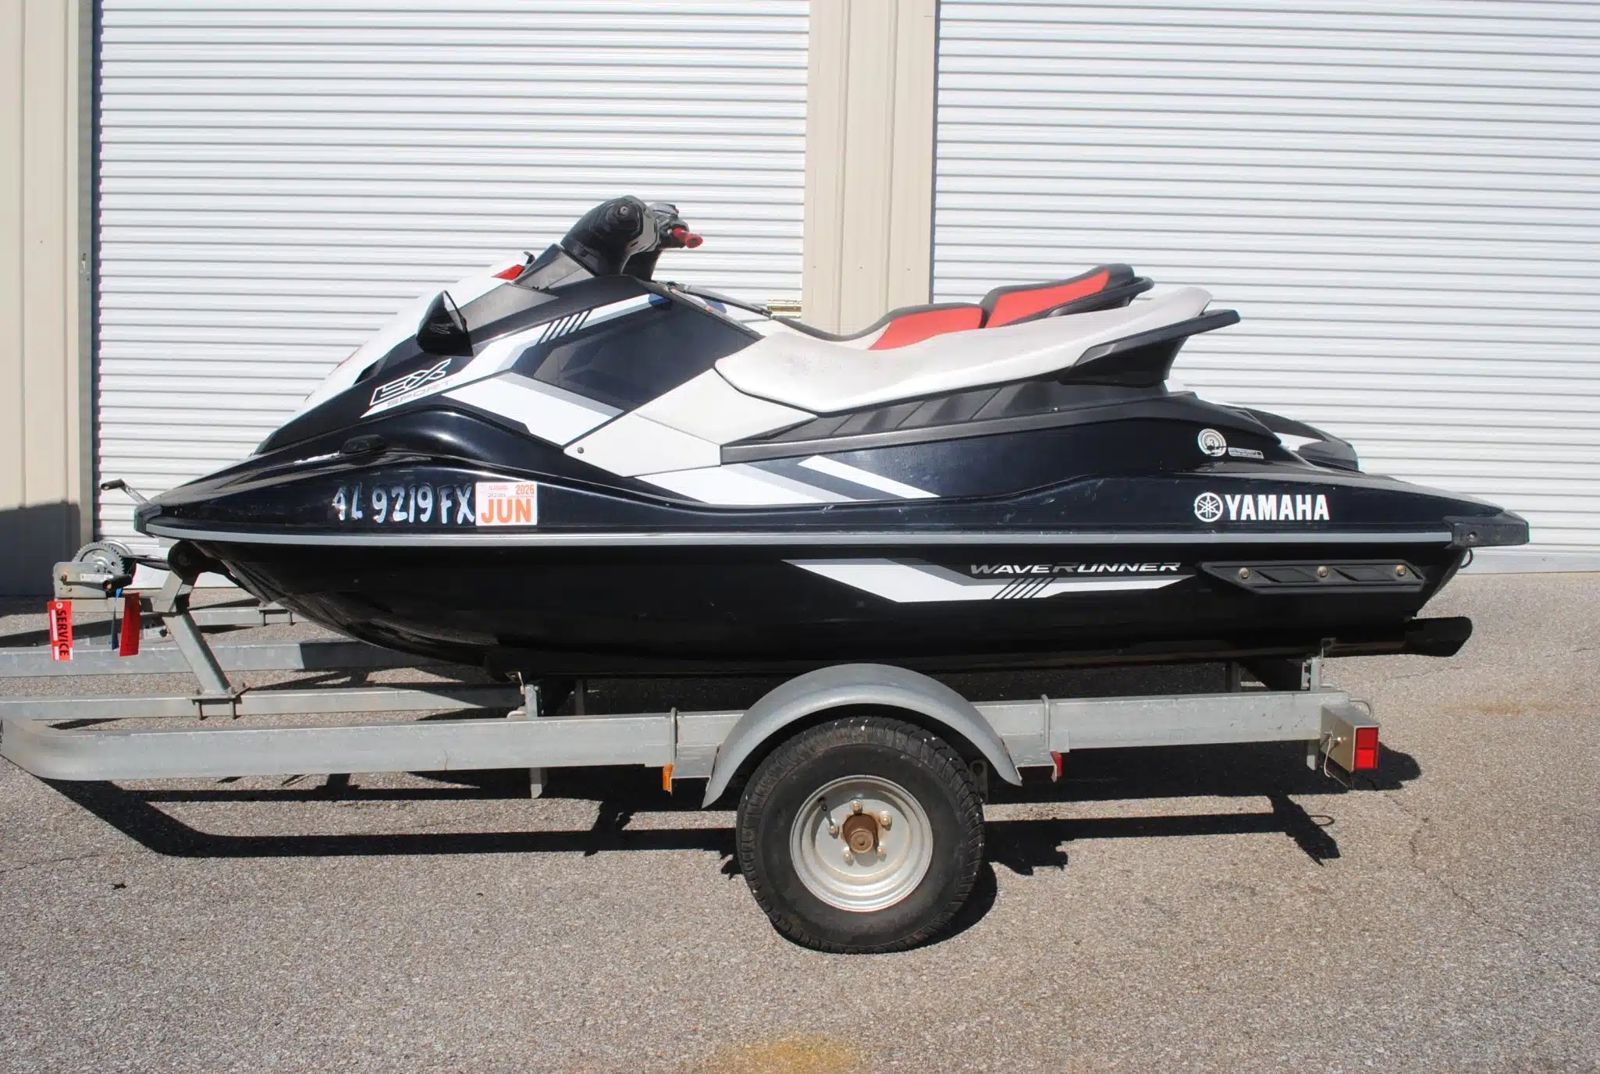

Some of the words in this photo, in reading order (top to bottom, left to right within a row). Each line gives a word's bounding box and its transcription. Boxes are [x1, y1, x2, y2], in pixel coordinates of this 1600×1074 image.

[515, 484, 535, 495] 2026
[481, 498, 532, 524] JUN
[1224, 494, 1330, 521] YAMAHA
[56, 610, 70, 657] SERVICE
